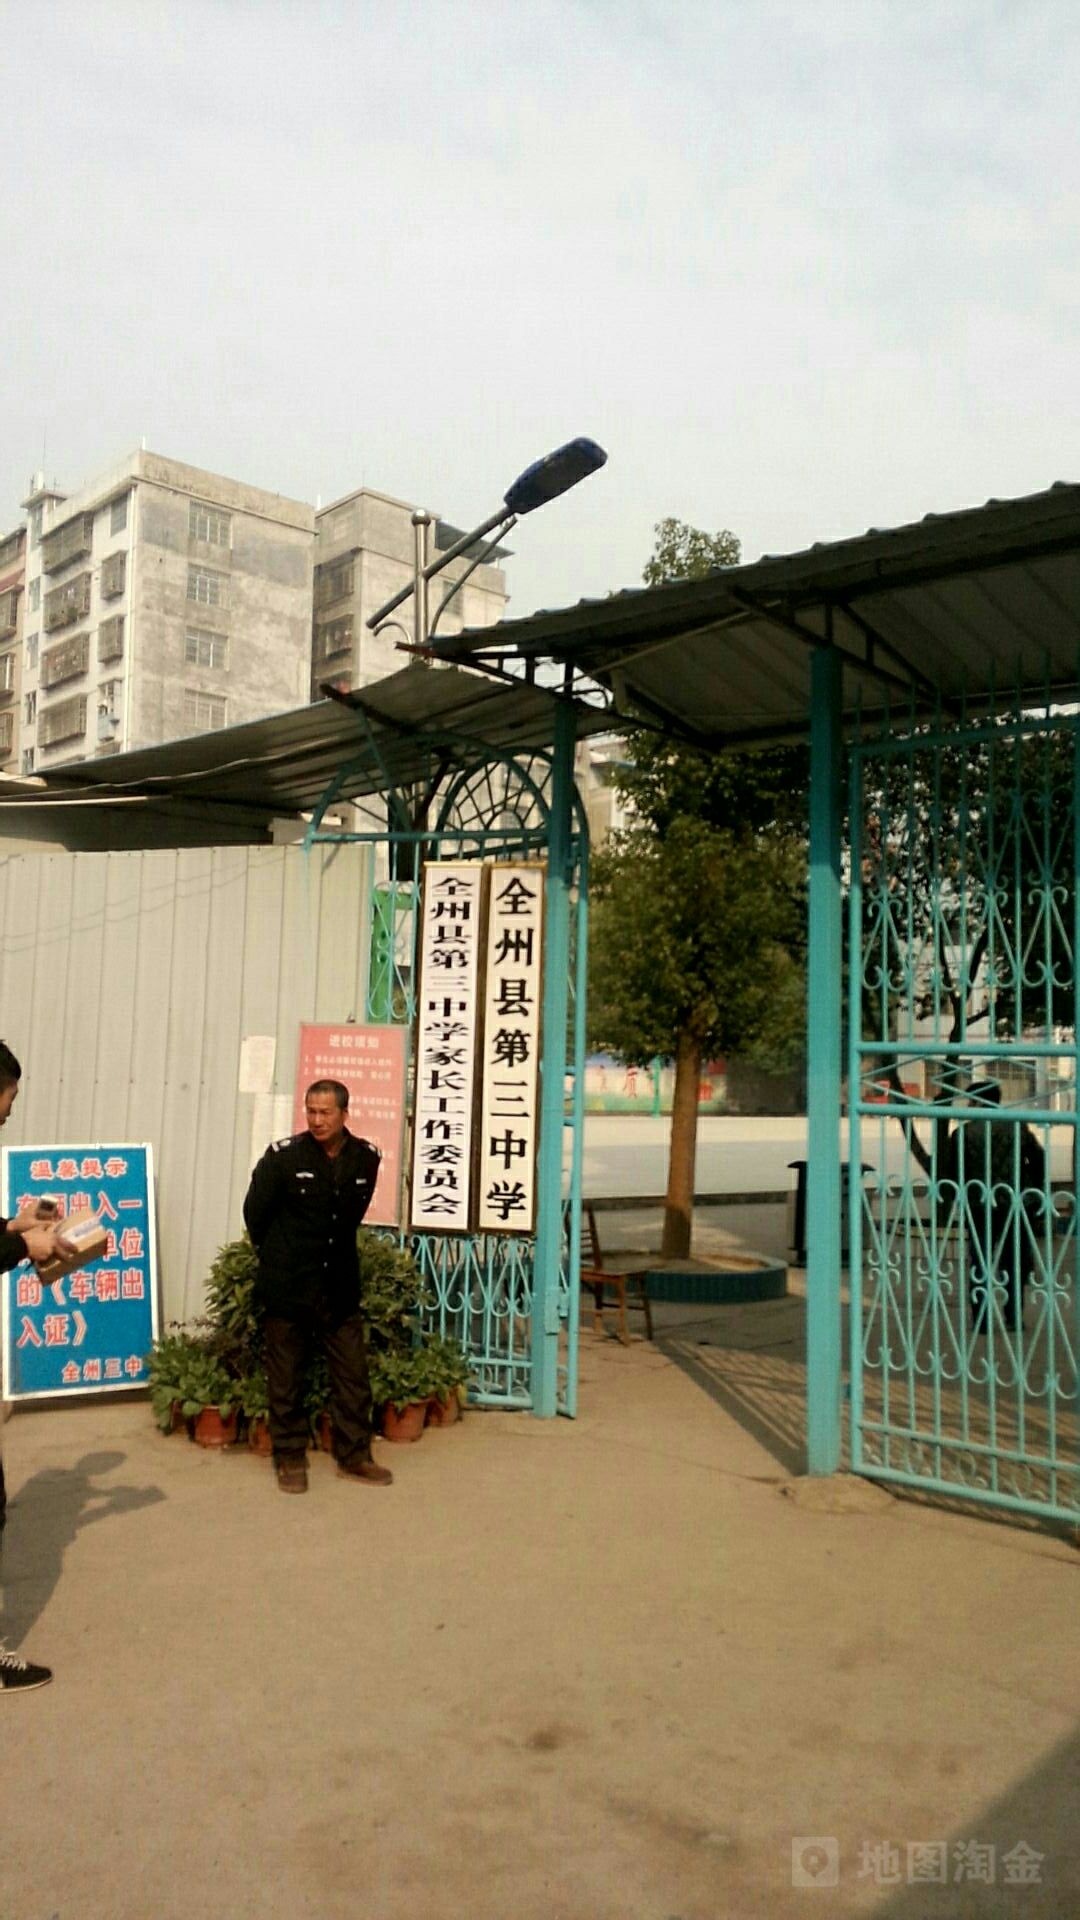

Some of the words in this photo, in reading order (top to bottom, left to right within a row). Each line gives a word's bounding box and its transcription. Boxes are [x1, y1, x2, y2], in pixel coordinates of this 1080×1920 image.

[420, 877, 474, 1215] 全州县第三中学家长工作委员会
[485, 877, 537, 1221] 全州县第三中学
[30, 1157, 128, 1180] 温馨提示
[16, 1310, 87, 1348] 入证》
[61, 1355, 143, 1383] 全州三中
